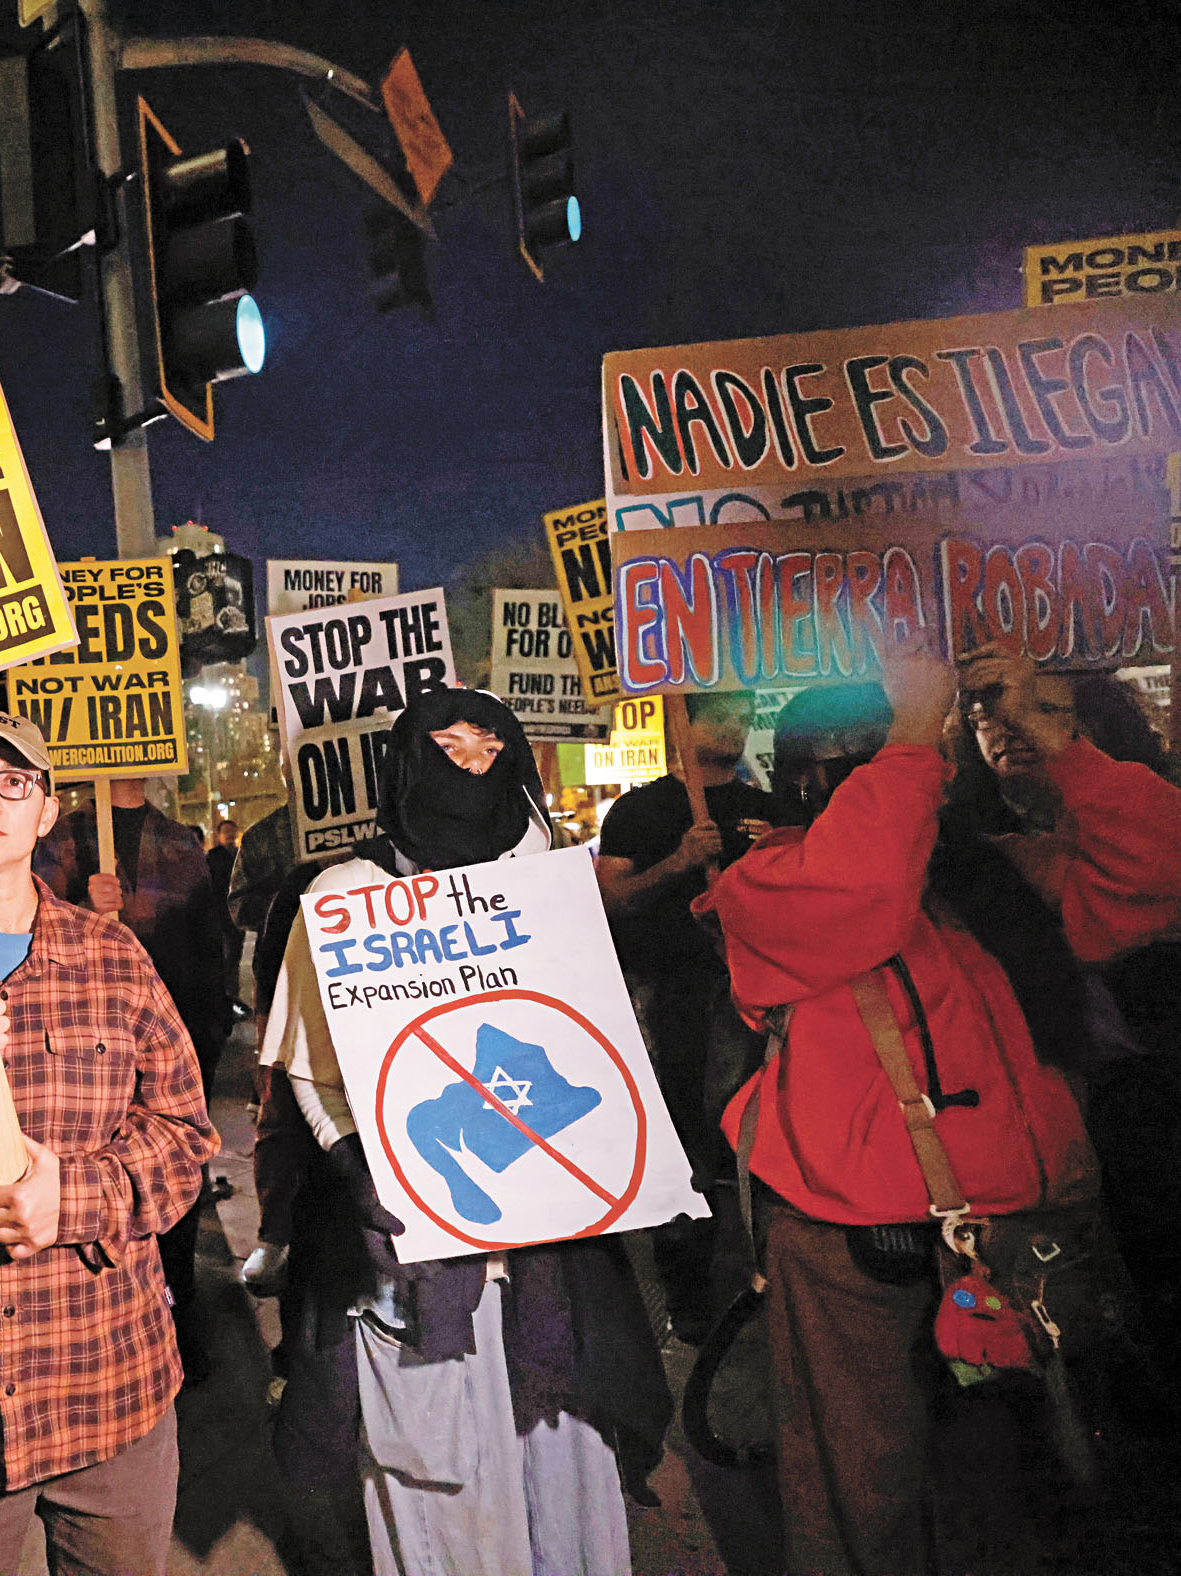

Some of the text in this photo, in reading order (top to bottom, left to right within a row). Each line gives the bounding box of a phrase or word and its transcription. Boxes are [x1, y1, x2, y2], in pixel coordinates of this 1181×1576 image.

[619, 367, 846, 480] NADIE
[845, 354, 950, 464] ES
[110, 565, 164, 580] FOR
[284, 569, 382, 593] MONEY FOR
[503, 602, 564, 628] NO BL
[620, 554, 719, 689] EN
[714, 547, 926, 681] TIERRA
[281, 602, 443, 678] STOP THE
[506, 629, 550, 658] FOR
[16, 676, 84, 695] NOT
[91, 671, 170, 691] WAR
[509, 672, 555, 695] FUND
[17, 691, 174, 742] W/ IRAN
[297, 736, 356, 821] ON
[594, 749, 658, 768] ON IRAN
[314, 873, 508, 934] STOP the
[319, 910, 531, 977] ISRAELI
[328, 965, 518, 1010] Expansion Plan
